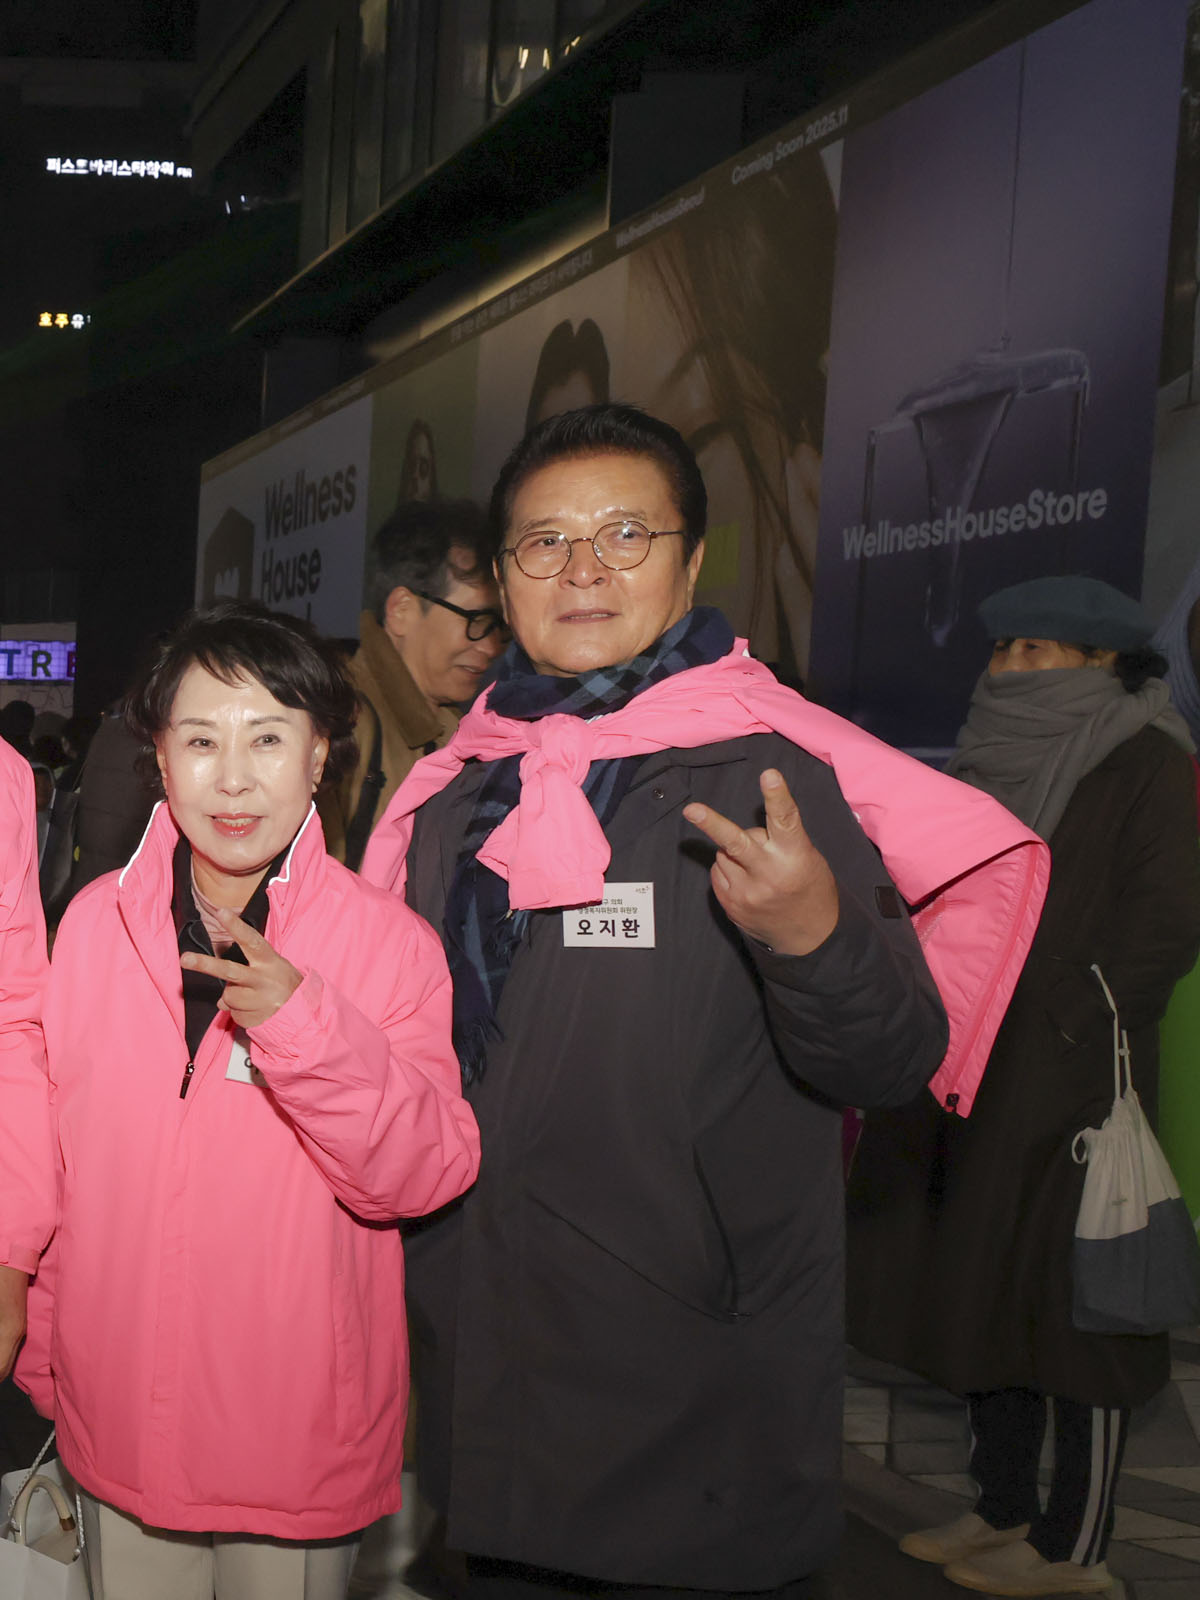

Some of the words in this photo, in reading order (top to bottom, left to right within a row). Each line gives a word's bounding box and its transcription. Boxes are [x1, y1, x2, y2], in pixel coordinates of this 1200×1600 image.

[731, 152, 774, 185] Coming
[775, 133, 804, 162] Soon
[264, 464, 358, 542] Wellness
[842, 488, 1108, 561] WellnessHouseStore
[260, 548, 322, 603] House
